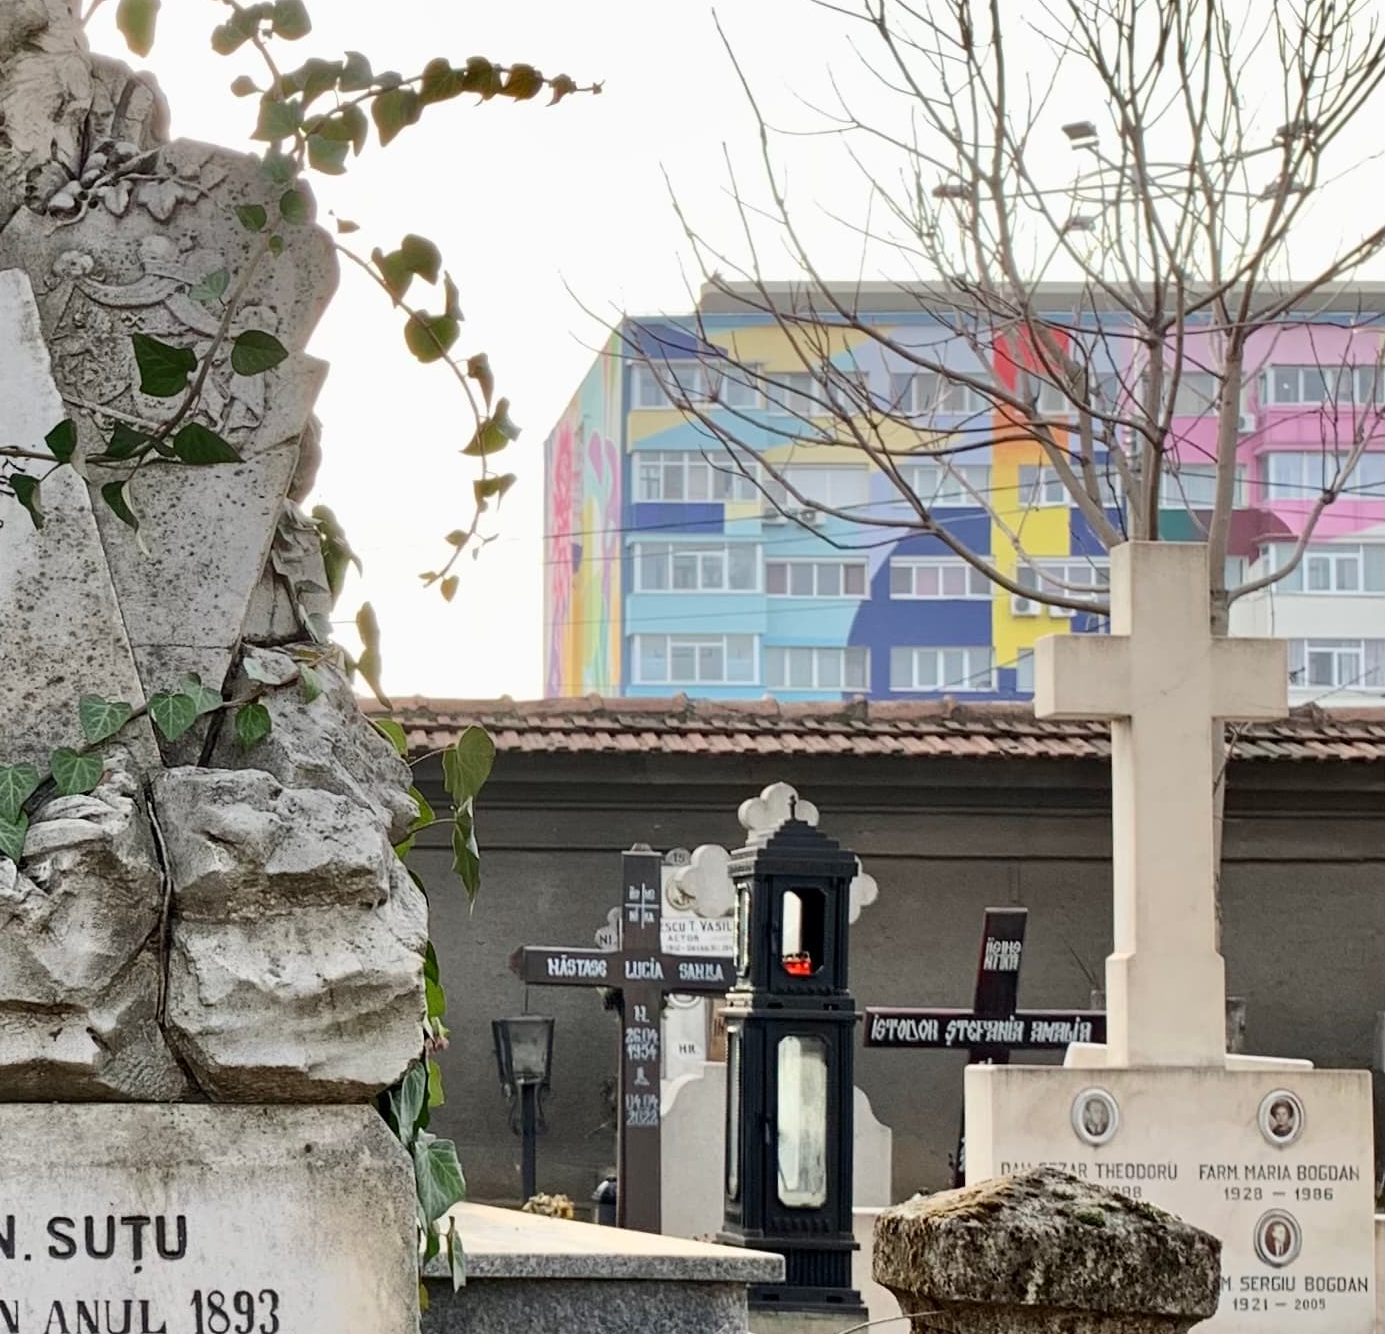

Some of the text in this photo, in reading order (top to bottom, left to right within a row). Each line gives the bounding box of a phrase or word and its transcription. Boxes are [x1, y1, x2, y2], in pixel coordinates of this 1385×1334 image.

[1095, 1162, 1178, 1181] THEODORU
[1244, 1164, 1292, 1181] MARIA
[1296, 1164, 1360, 1181] BOGDAN
[1224, 1187, 1263, 1201] 1928
[1295, 1187, 1334, 1201] 1986
[46, 1215, 188, 1274] SUȚU
[1240, 1276, 1296, 1292] SERGIU
[1304, 1276, 1369, 1293] BOGDAN
[1233, 1297, 1269, 1311] 1921
[1294, 1297, 1326, 1311] 2005
[43, 1299, 167, 1334] ANUL
